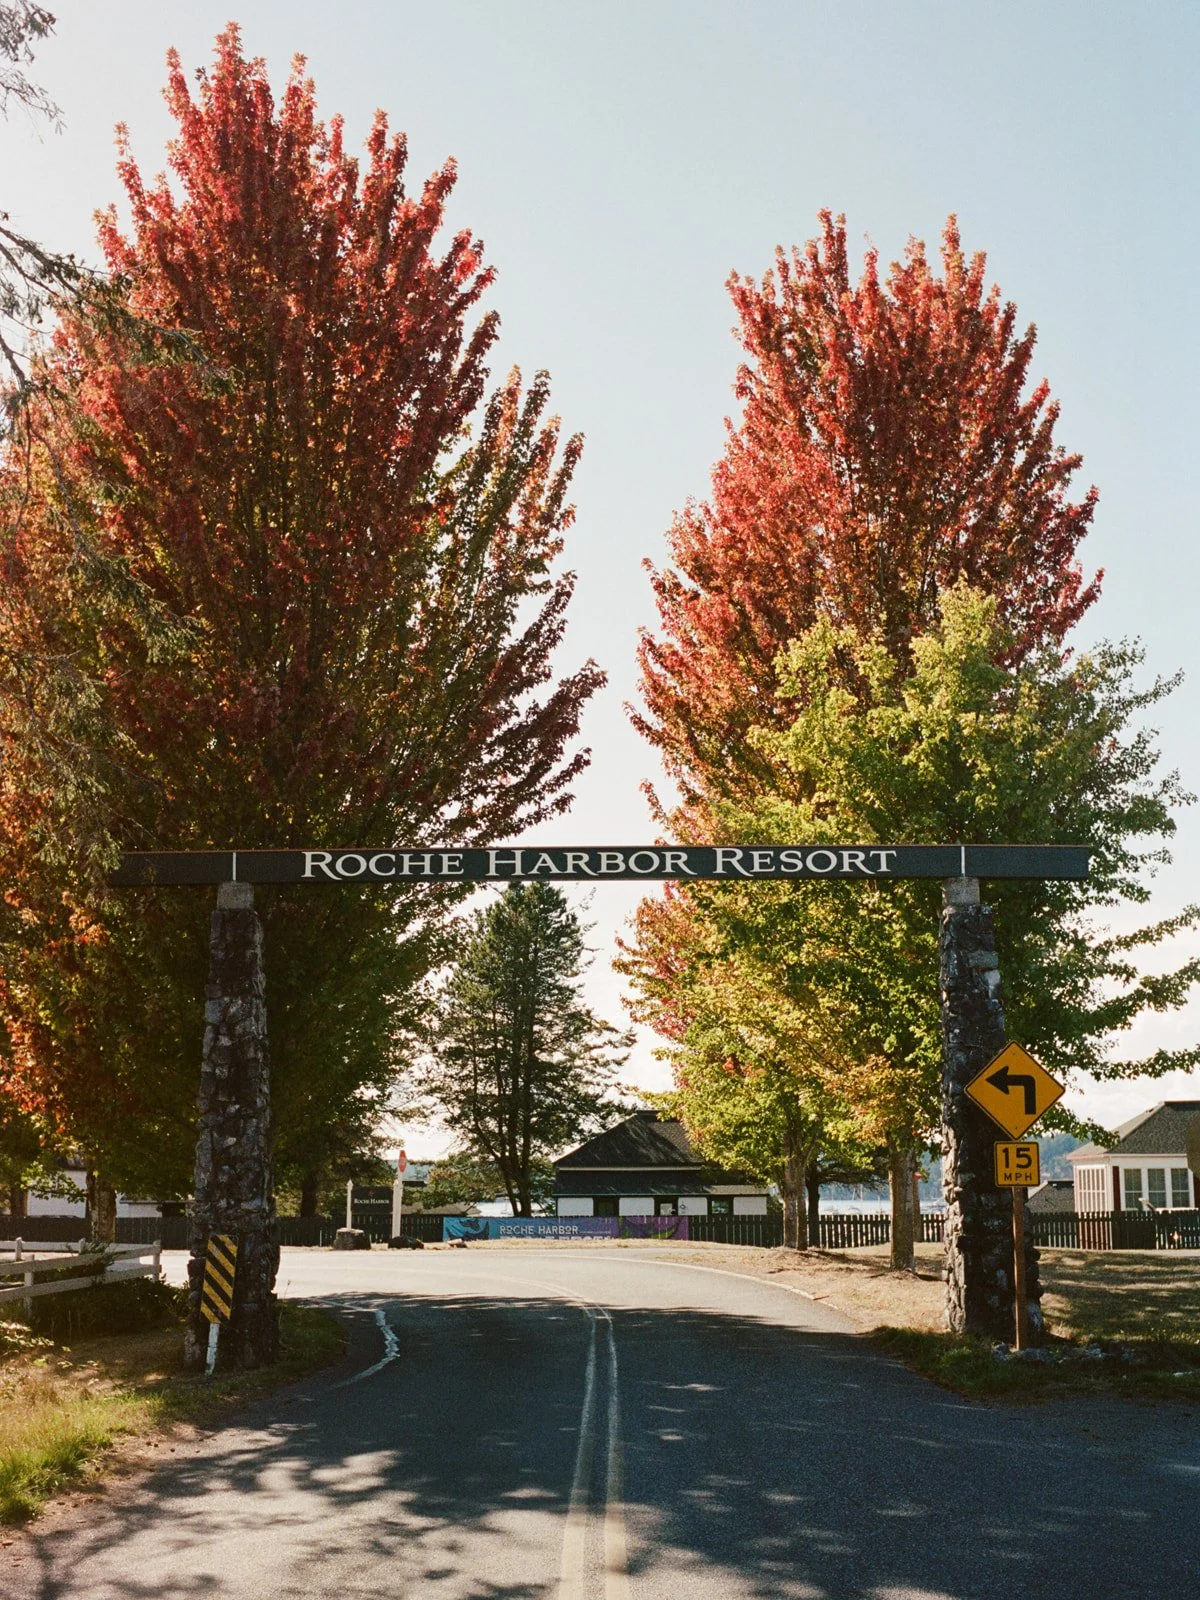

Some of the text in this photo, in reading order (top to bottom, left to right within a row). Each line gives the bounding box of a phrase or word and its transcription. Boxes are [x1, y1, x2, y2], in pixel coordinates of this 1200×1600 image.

[301, 848, 897, 880] ROCHE HARBOR RESORT
[1002, 1147, 1032, 1169] 15
[1003, 1172, 1032, 1182] MPH
[500, 1225, 535, 1235] ROCHE
[538, 1225, 579, 1235] HARBOR
